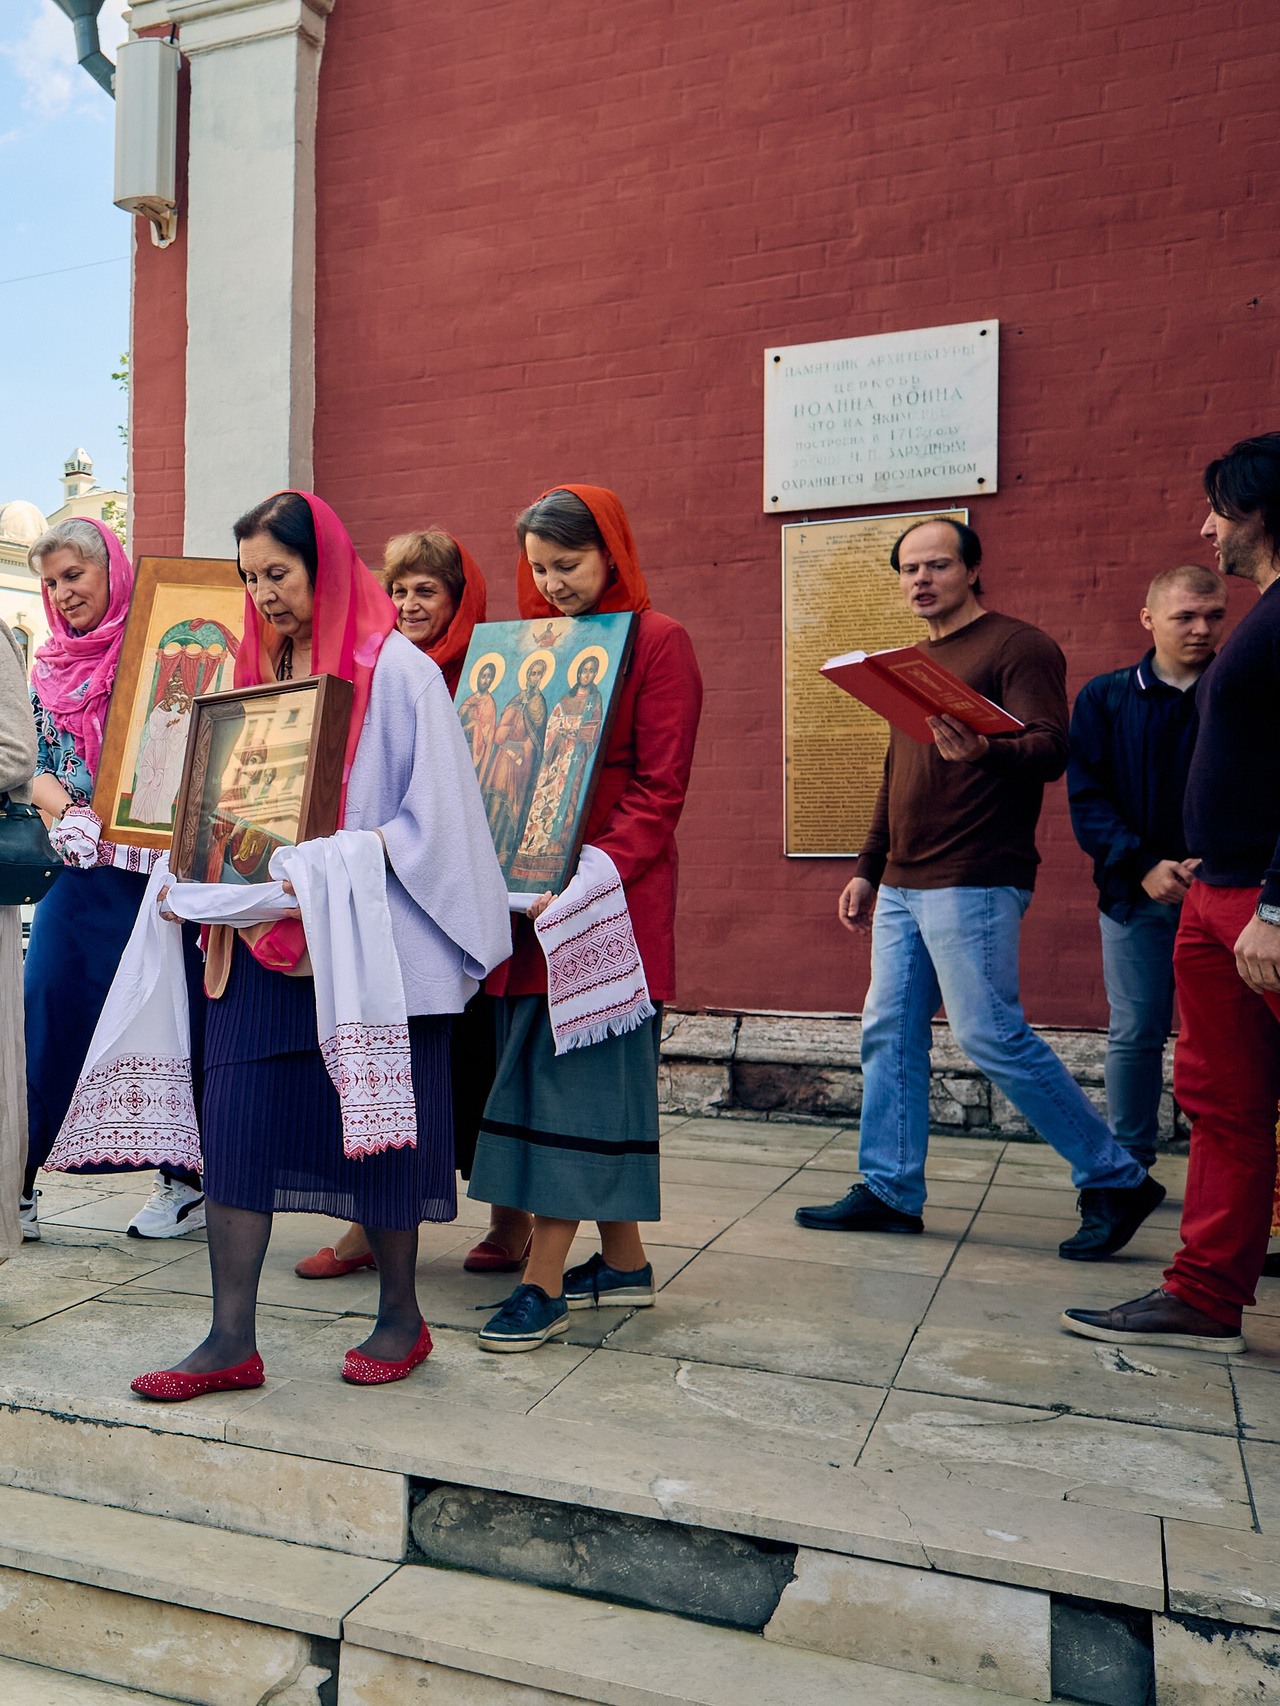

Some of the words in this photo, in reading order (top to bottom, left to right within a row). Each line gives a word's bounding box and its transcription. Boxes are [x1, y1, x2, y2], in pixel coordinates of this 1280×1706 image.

[784, 358, 859, 378] ПАМЯТНИК
[867, 343, 975, 368] АРХИТЕКТУРЫ
[833, 374, 921, 394] ЦЕРКОВЬ
[793, 396, 874, 418] ИОАННА
[888, 440, 967, 460] ЗАРУДНЫМ
[781, 472, 864, 491] ОХРАНЯЕТСЯ
[874, 461, 977, 482] ГОСУДАРСТВОМ
